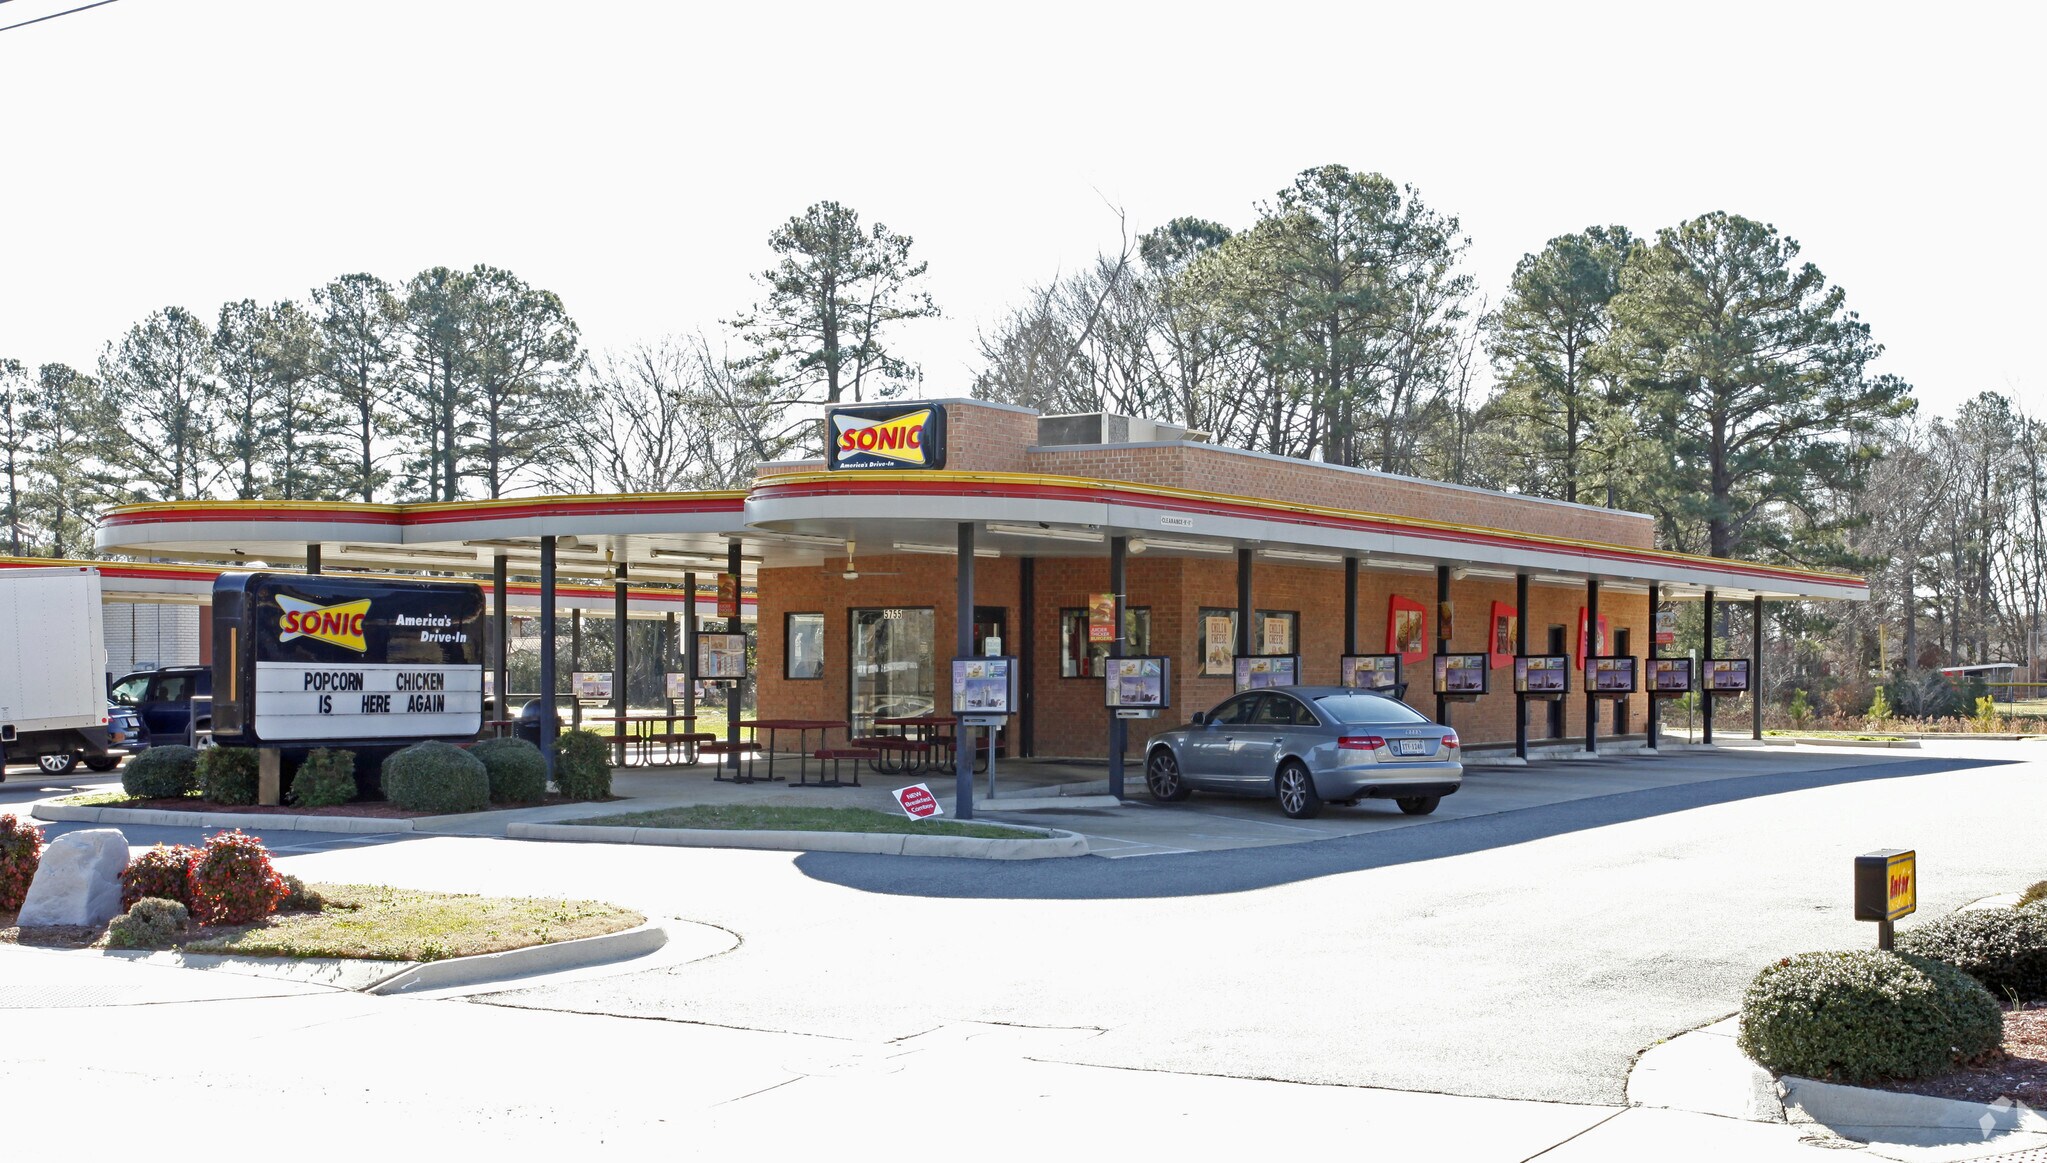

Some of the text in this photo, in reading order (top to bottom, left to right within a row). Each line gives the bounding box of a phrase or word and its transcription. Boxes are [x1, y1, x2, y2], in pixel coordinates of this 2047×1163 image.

[840, 425, 923, 452] SONIC
[840, 461, 868, 469] America's
[884, 609, 902, 619] 5755
[283, 610, 366, 637] SONIC
[395, 613, 452, 627] America's
[1211, 634, 1227, 644] CHEESE
[1269, 634, 1284, 645] CHEESE
[304, 671, 444, 691] POPCORN CHICKEN
[319, 694, 445, 714] IS HERE AGAIN
[906, 791, 922, 799] NEW
[904, 796, 932, 807] Breakfast
[911, 803, 934, 812] Combos
[1889, 873, 1909, 899] Enter
